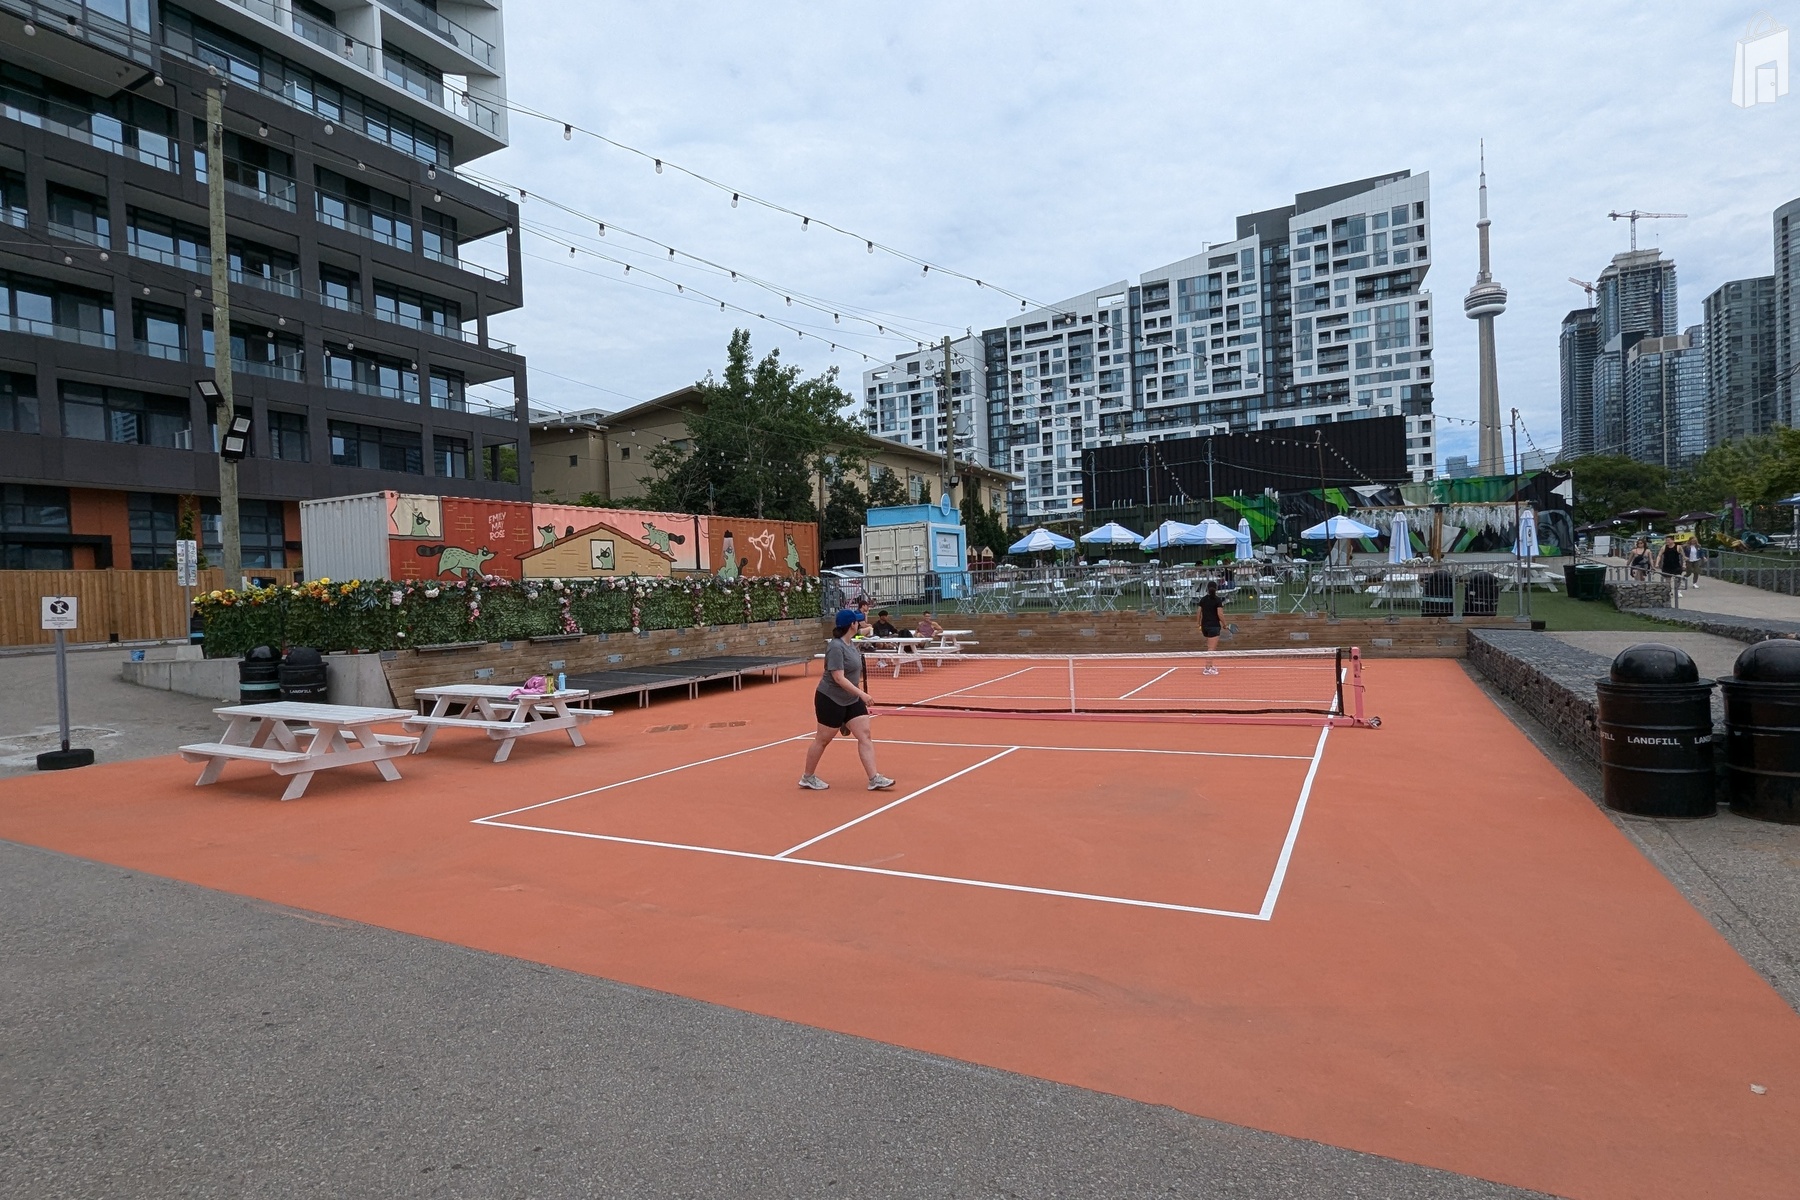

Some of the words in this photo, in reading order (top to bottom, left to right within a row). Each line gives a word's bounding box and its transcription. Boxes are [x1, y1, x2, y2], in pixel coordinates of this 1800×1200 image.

[939, 357, 964, 367] mnto
[489, 530, 505, 541] ROSE
[1627, 735, 1681, 746] LANDFILL
